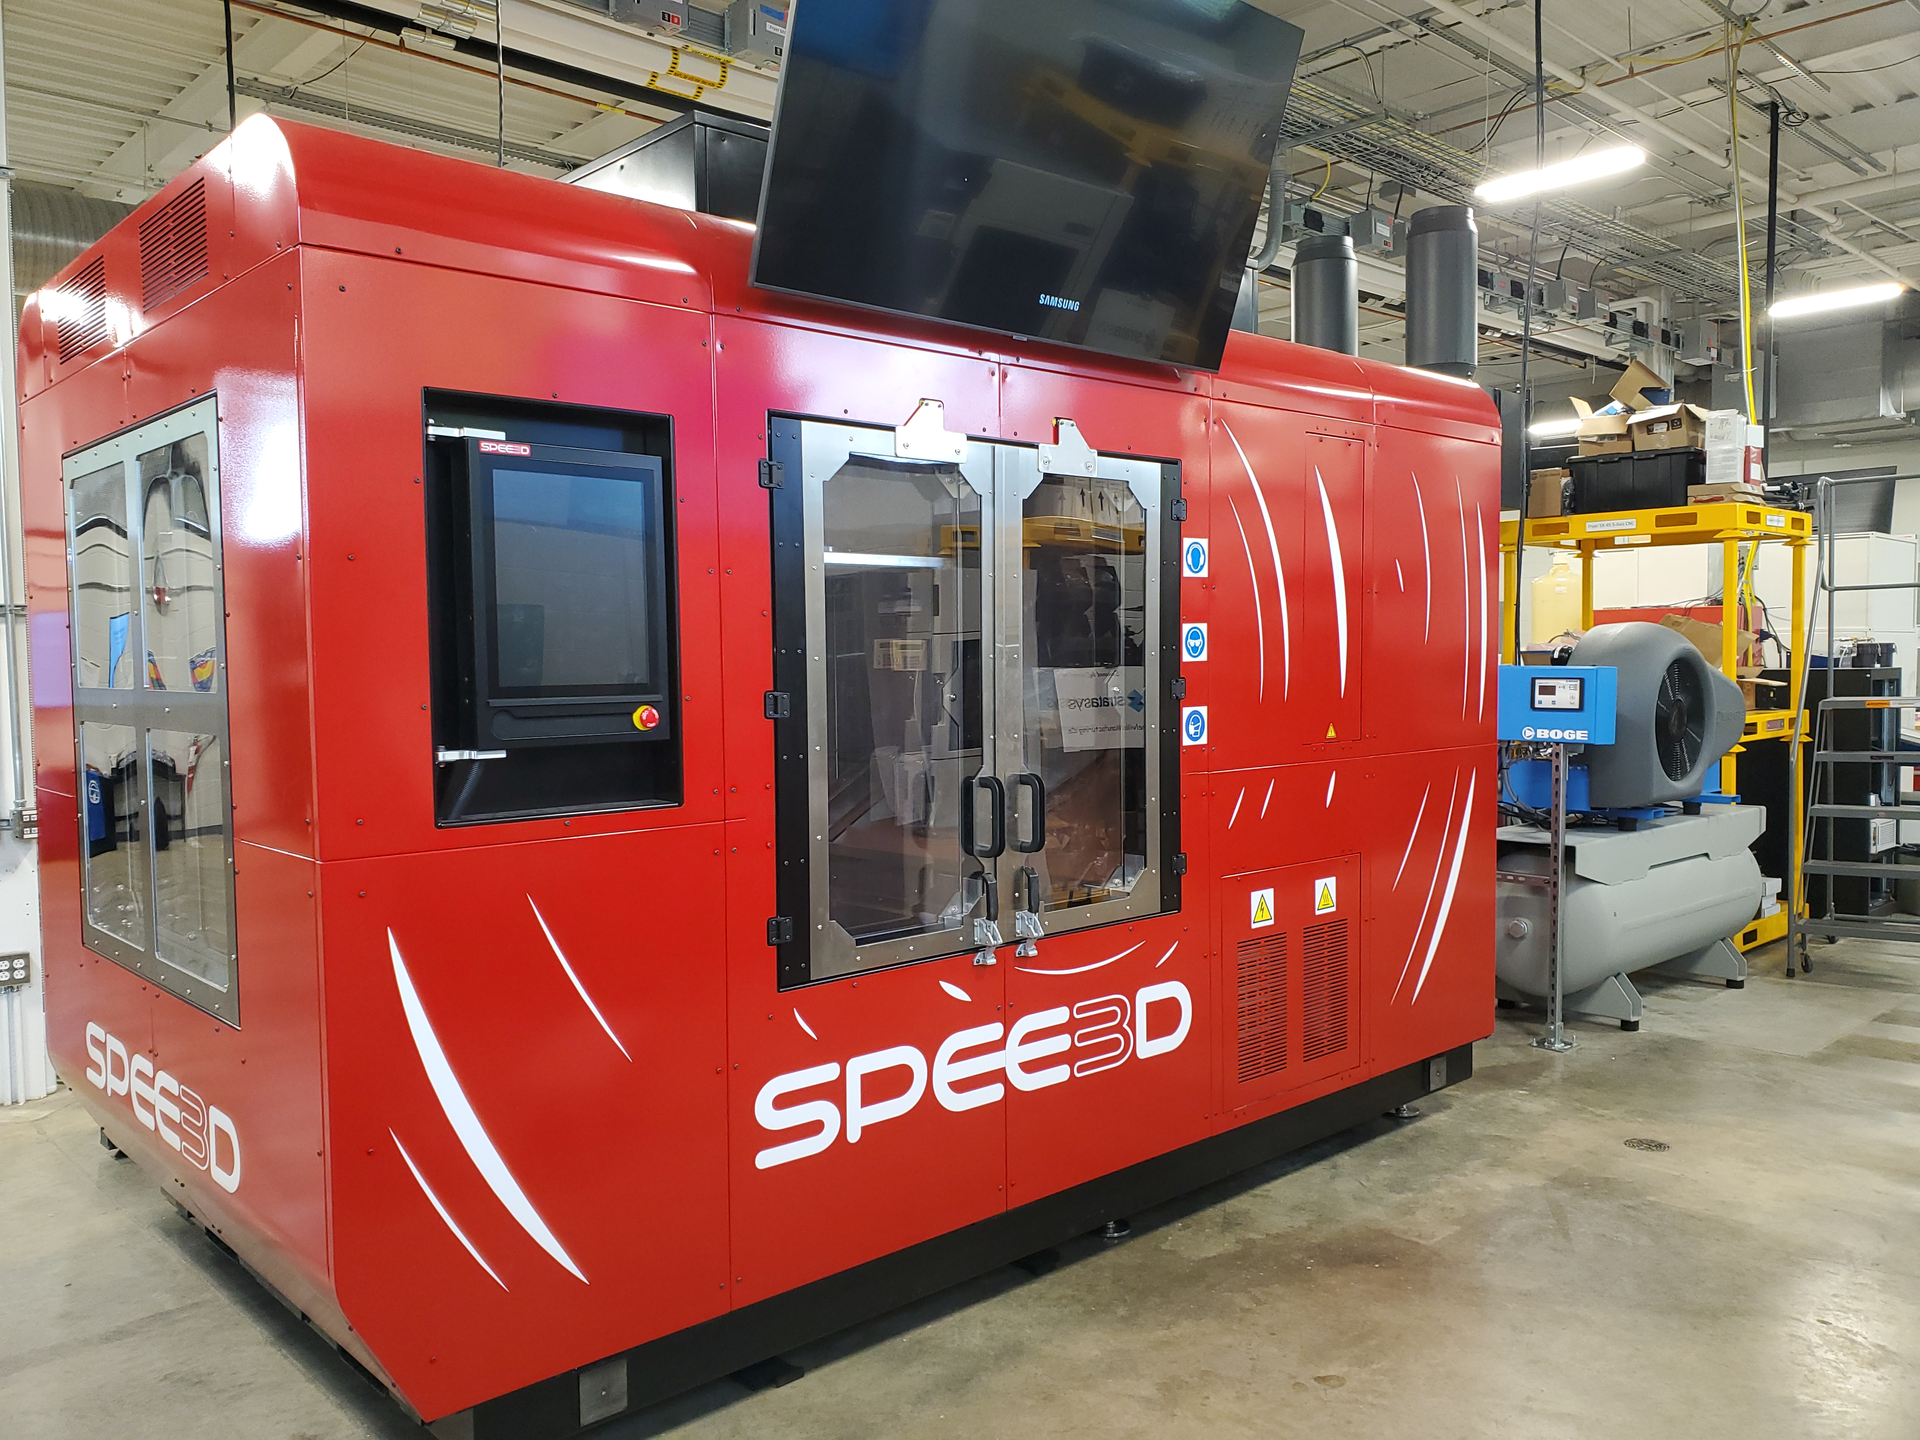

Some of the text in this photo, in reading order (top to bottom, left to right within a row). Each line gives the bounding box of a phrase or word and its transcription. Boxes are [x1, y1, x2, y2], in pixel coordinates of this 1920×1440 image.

[1039, 293, 1080, 311] SAMSUNG
[1536, 728, 1588, 741] BOGE
[85, 1021, 241, 1194] SPEE3D
[755, 980, 1192, 1170] SPEE3D
